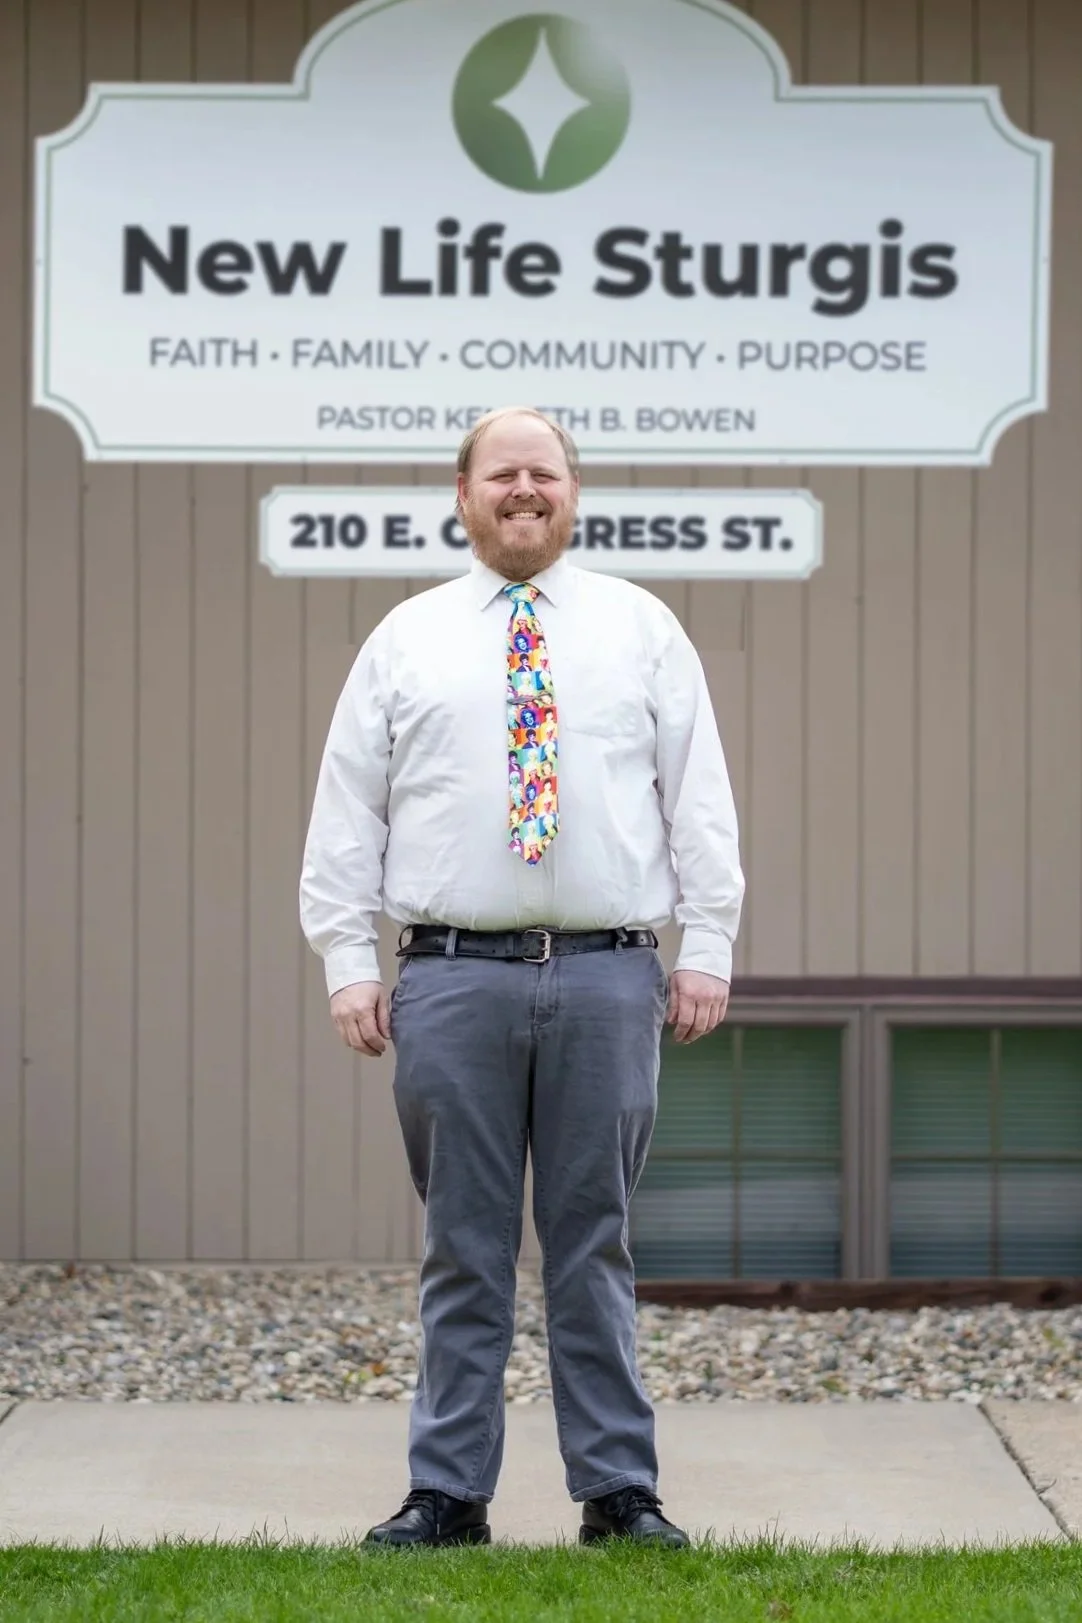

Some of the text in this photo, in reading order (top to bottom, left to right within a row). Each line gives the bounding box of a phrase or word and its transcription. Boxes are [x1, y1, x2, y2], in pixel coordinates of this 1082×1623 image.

[122, 216, 959, 318] New Life Sturgis
[149, 337, 926, 372] FAITH FAMILY COMMUNITY PURPOSE
[317, 405, 757, 433] PASTOR KETH B. BOWEN
[290, 514, 793, 551] 210 E. CRESS ST.
